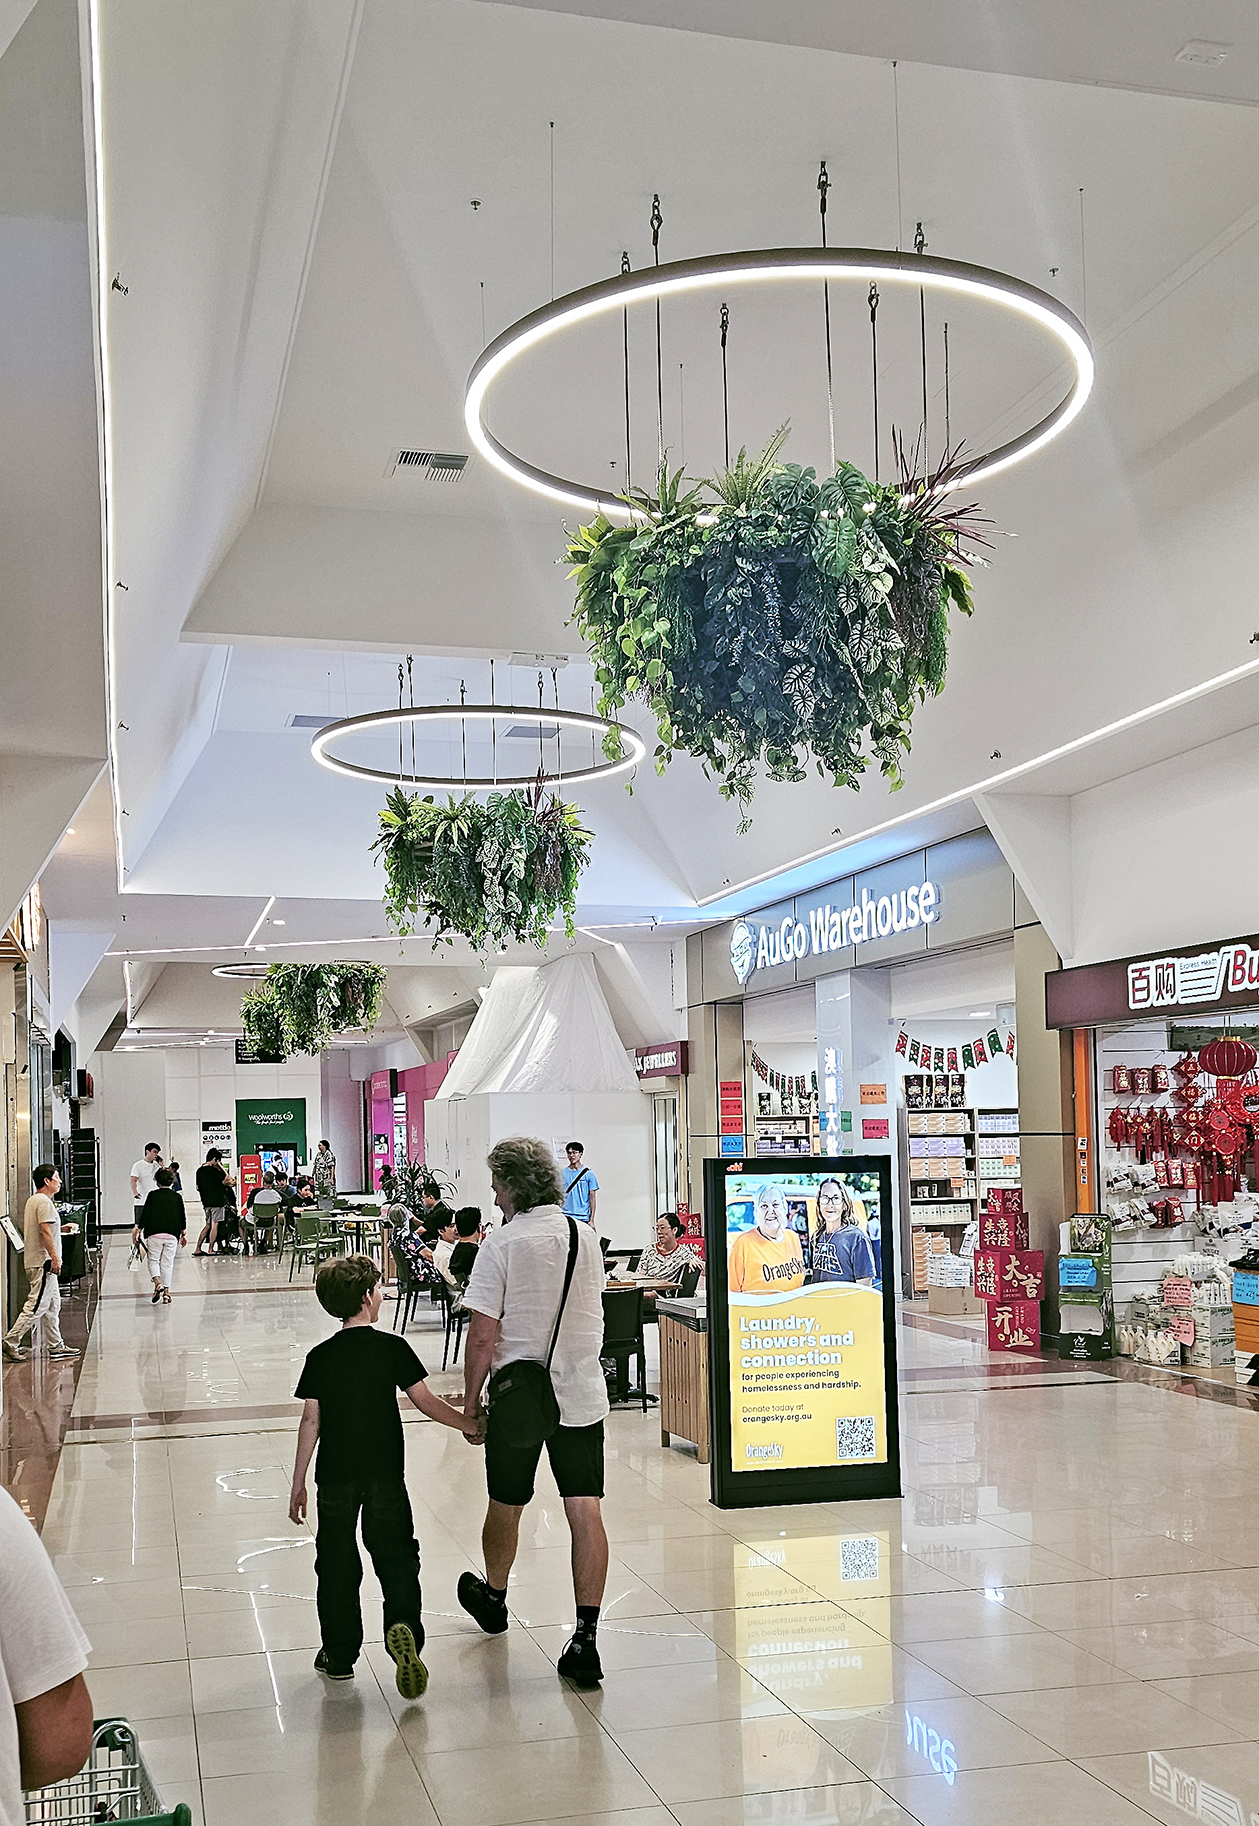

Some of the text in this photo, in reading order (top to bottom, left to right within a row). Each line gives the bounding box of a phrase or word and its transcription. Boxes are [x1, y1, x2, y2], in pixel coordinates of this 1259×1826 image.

[756, 881, 938, 969] AuGo Warehouse
[1131, 963, 1176, 1003] 百购
[643, 1051, 677, 1074] JEWELLERS
[248, 1112, 283, 1121] woolworths
[1002, 1255, 1041, 1298] 大吉
[740, 1314, 821, 1334] Laundry,
[991, 1306, 1034, 1348] 开业
[740, 1330, 854, 1350] showers and
[741, 1349, 842, 1368] connection
[742, 1369, 840, 1382] for people experiencing
[742, 1379, 861, 1393] homelessness and hardship.
[742, 1403, 804, 1413] Donate today at
[742, 1413, 812, 1424] orangesky.org.au
[745, 1443, 783, 1460] OrangeSky
